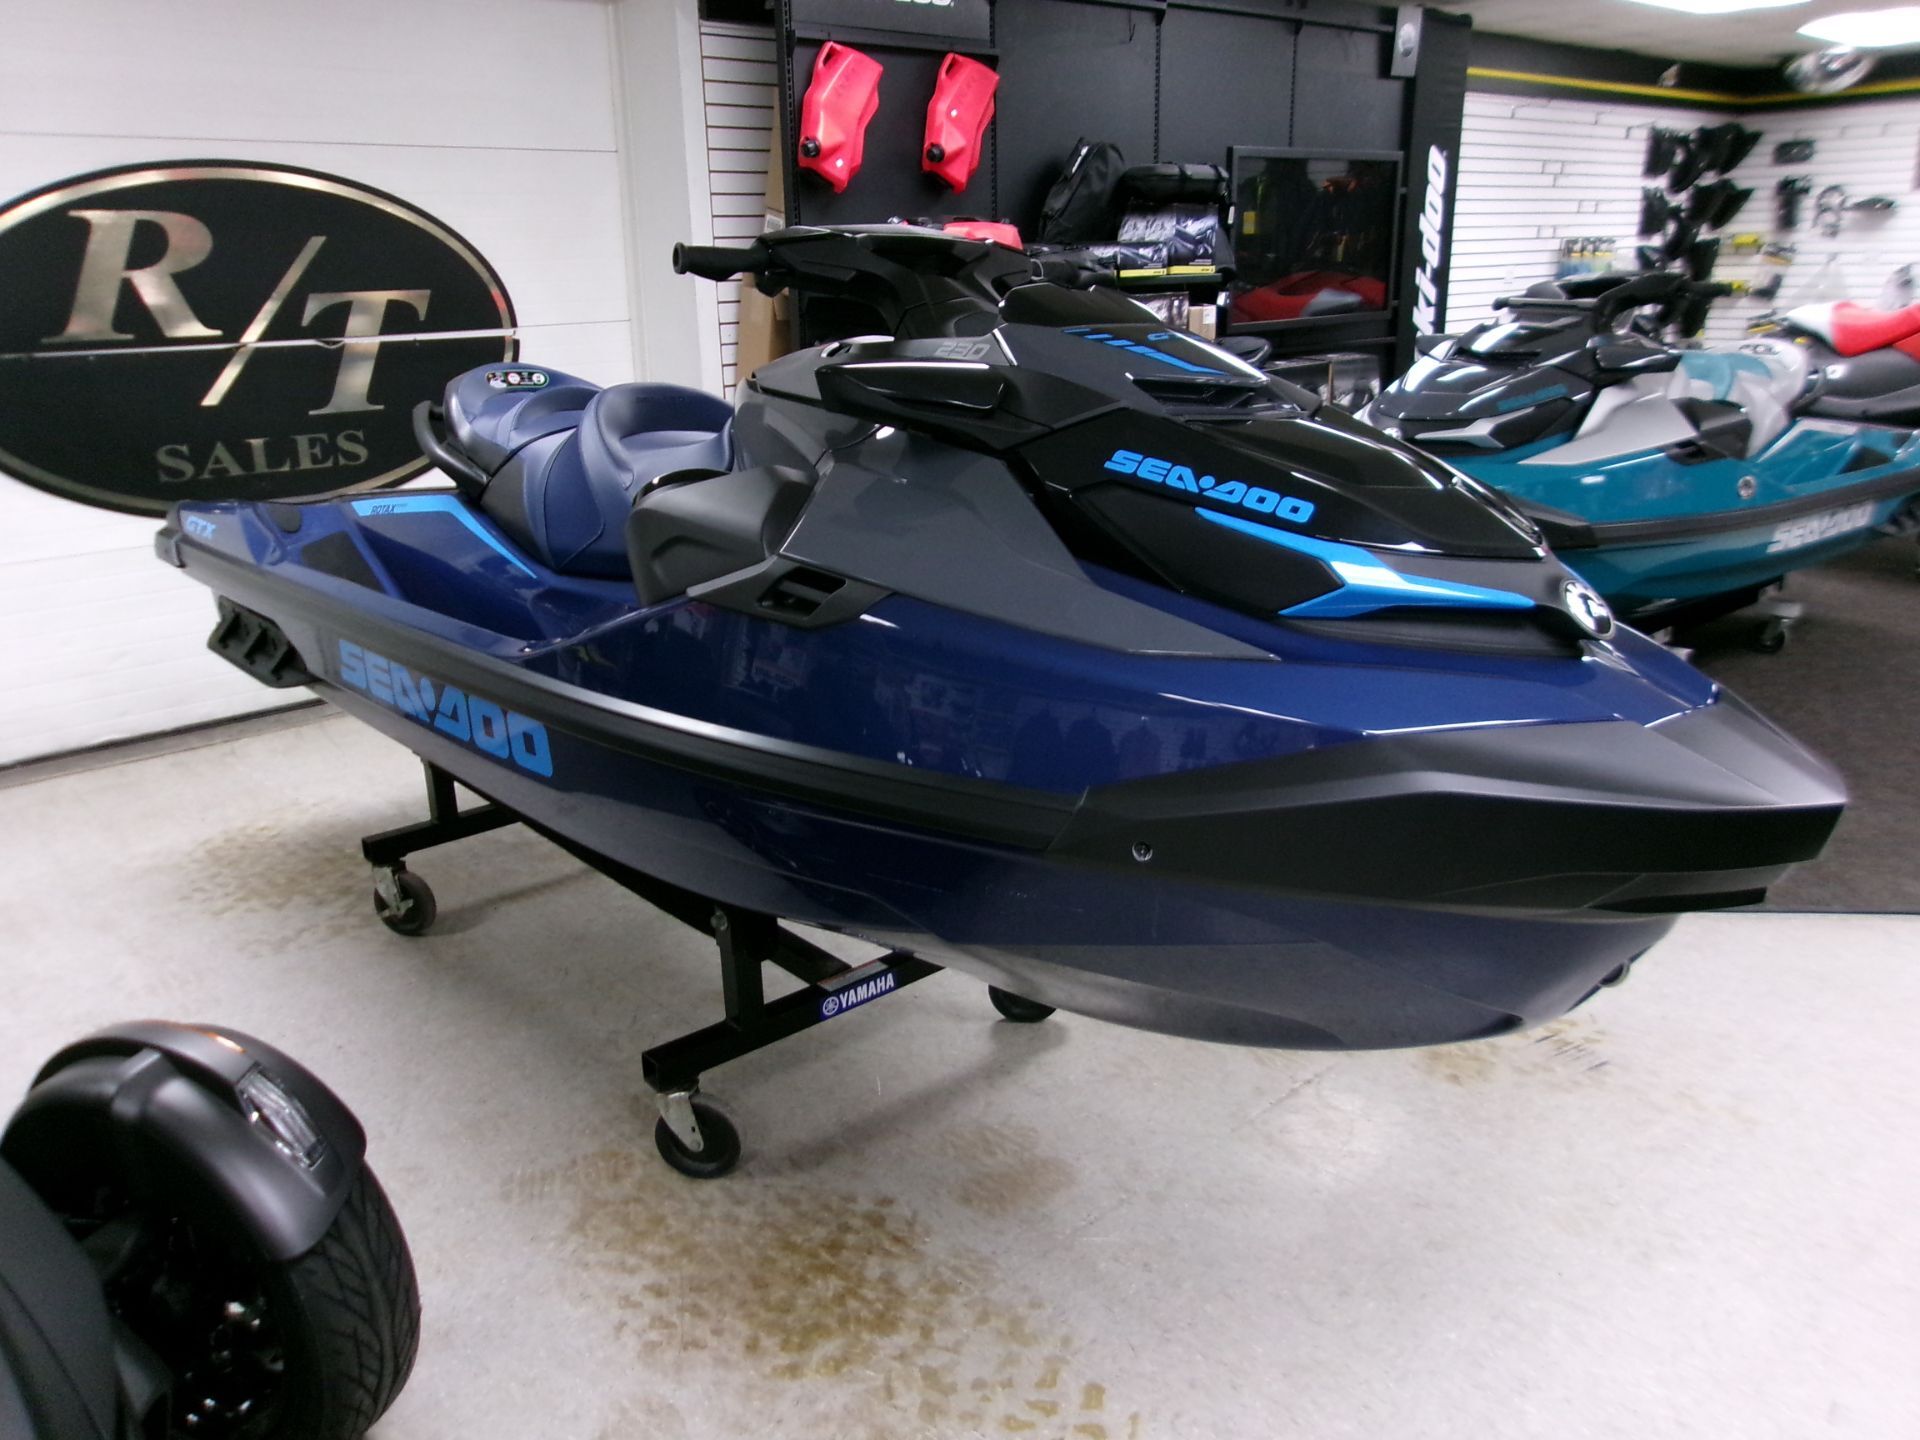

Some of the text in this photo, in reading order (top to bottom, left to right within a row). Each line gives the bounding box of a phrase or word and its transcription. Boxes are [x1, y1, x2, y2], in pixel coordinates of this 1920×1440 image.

[41, 209, 431, 415] R/T
[155, 430, 369, 483] SALES
[186, 515, 217, 540] GTX
[839, 972, 895, 1009] YAMAHA
